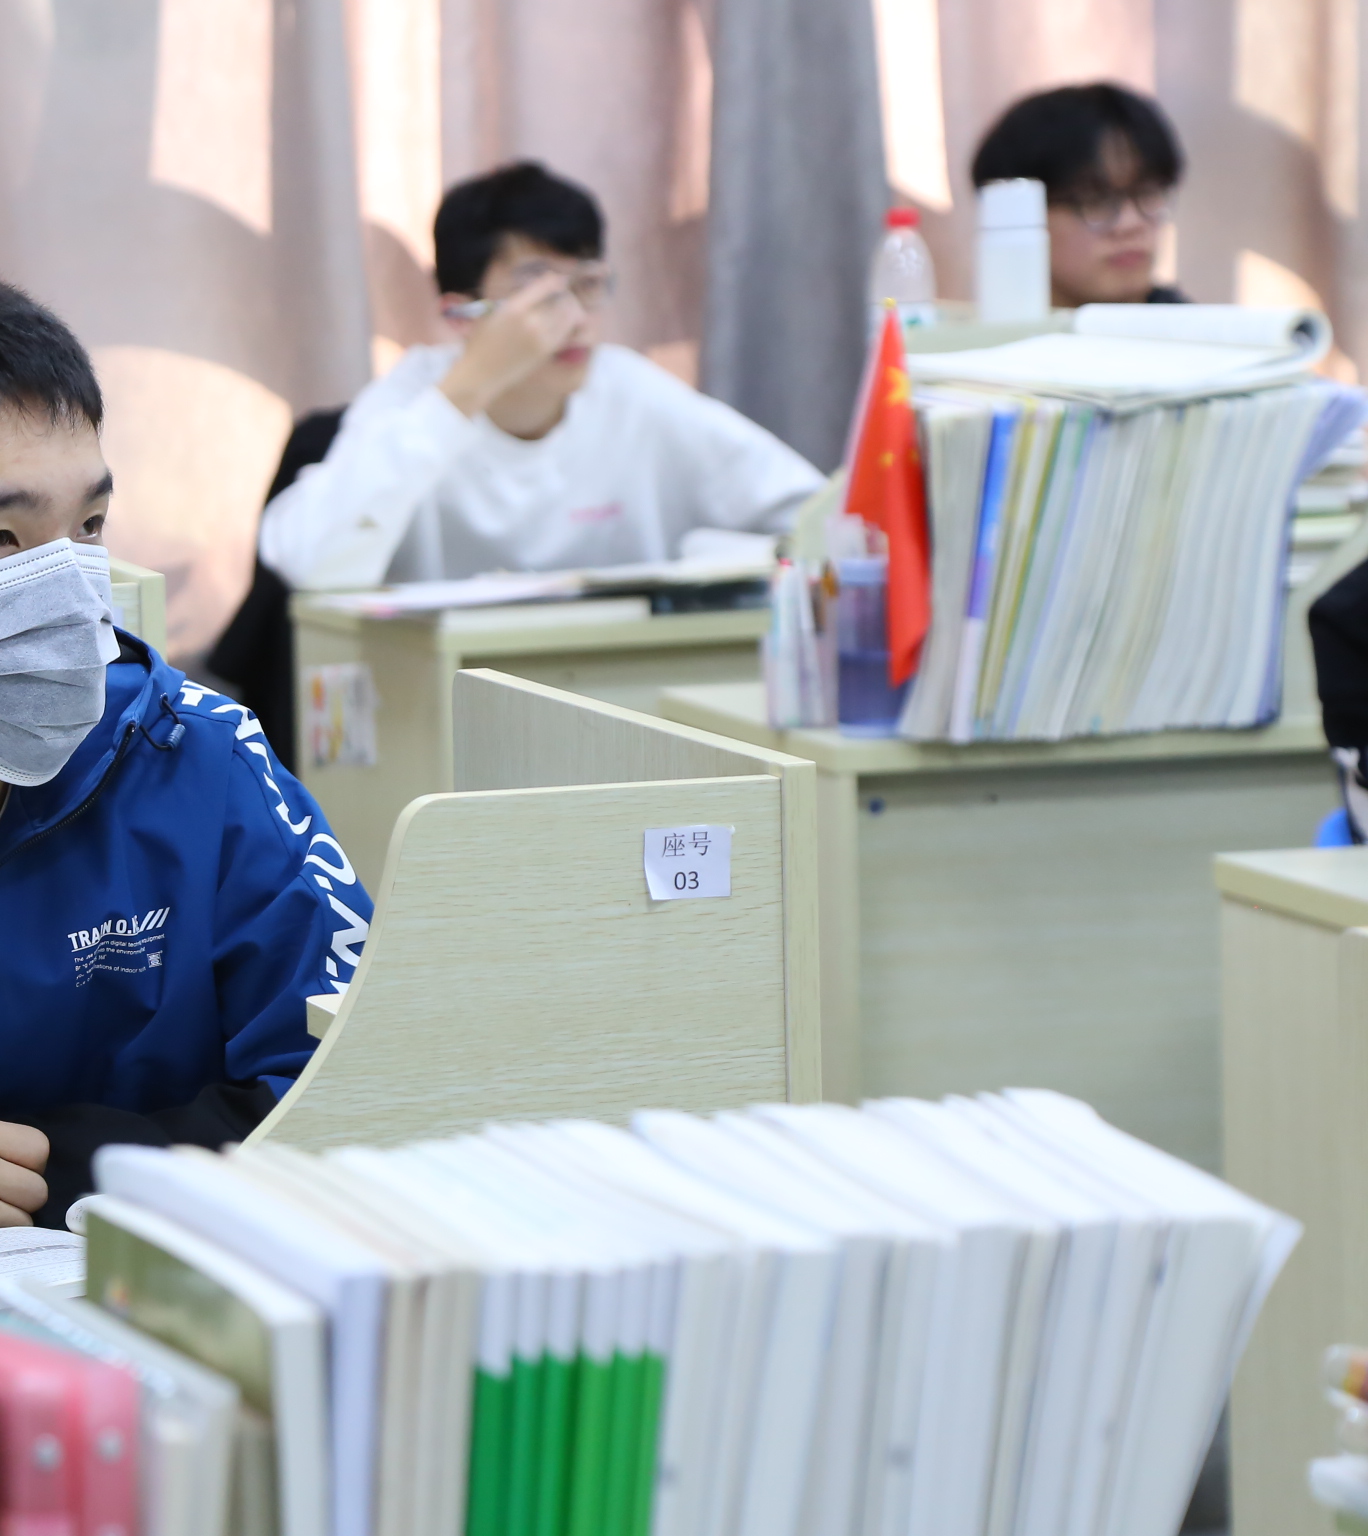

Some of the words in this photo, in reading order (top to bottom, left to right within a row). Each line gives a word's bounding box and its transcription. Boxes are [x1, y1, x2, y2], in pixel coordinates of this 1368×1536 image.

[661, 831, 712, 858] 座号
[674, 871, 700, 890] 03
[67, 919, 112, 951] TRAIN
